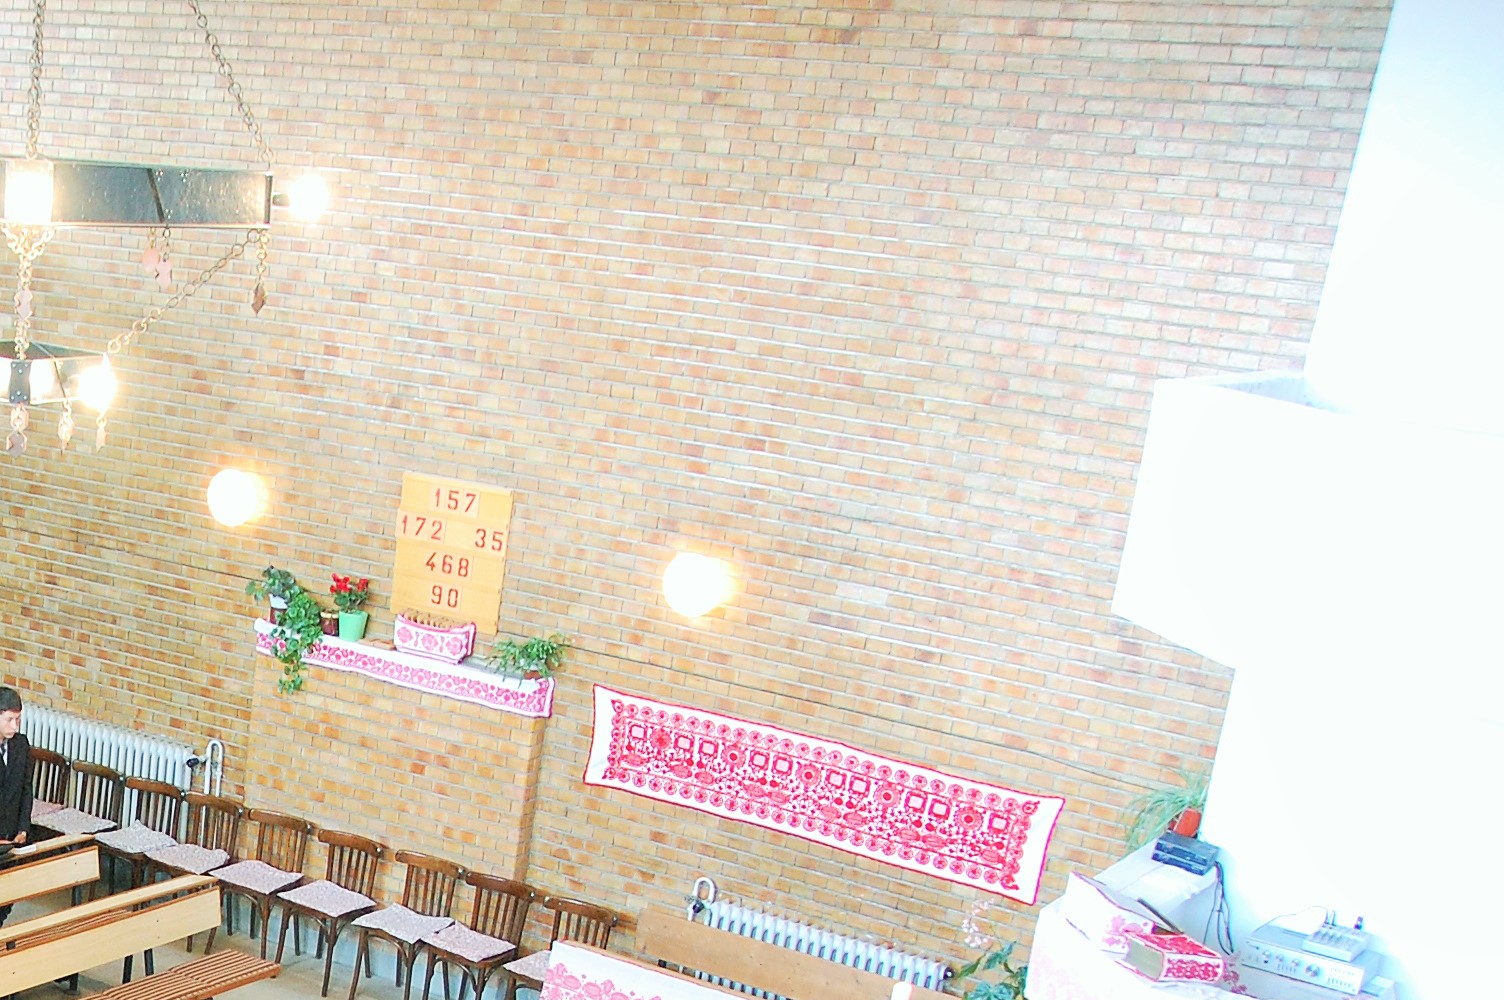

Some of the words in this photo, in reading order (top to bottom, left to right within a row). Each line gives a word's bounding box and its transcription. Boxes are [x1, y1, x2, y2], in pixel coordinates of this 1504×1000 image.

[434, 488, 477, 512] 157
[401, 515, 443, 540] 172
[475, 528, 504, 551] 35
[425, 552, 469, 578] 468
[431, 585, 459, 608] 90
